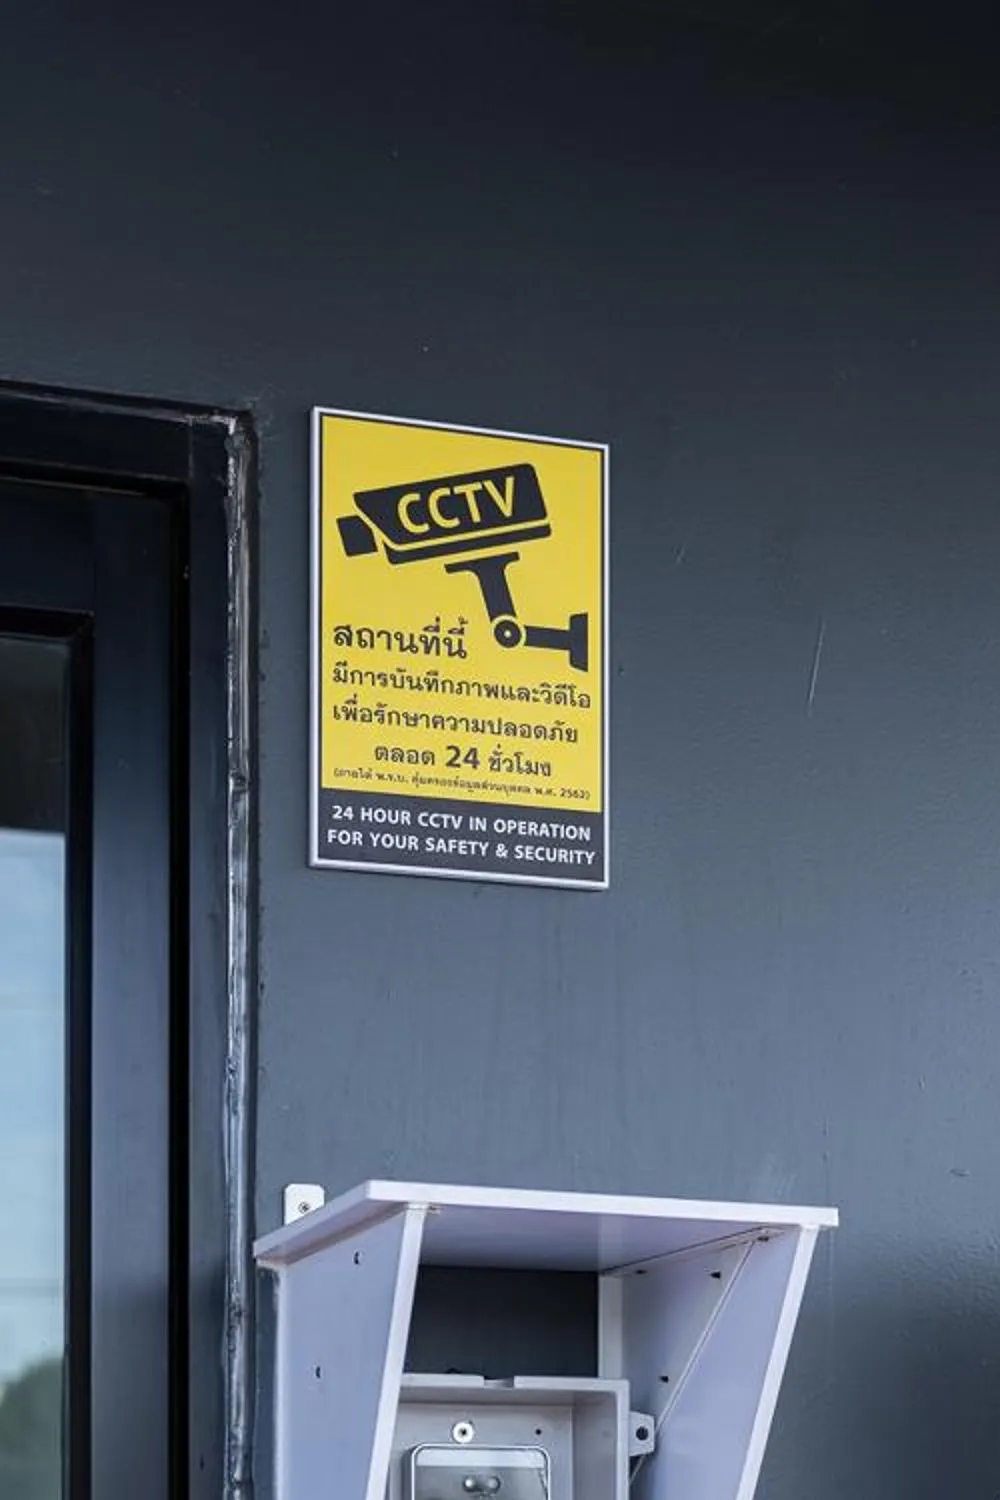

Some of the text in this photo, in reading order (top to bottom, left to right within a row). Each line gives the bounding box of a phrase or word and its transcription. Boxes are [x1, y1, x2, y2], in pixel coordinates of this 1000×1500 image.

[397, 476, 515, 534] CCTV
[333, 616, 468, 659] สถานที่นี้
[332, 661, 592, 709] มีการบันทึกภาพและวิดีโอ
[332, 694, 579, 744] เพื่อรักษาความปลอดภัย
[374, 744, 553, 777] ตลอด 24 ชั่วโมง
[332, 805, 592, 842] 24 HOUR CCTV IN OPERATION
[327, 829, 597, 866] FOR YOUR SAFETY & SECURITY
